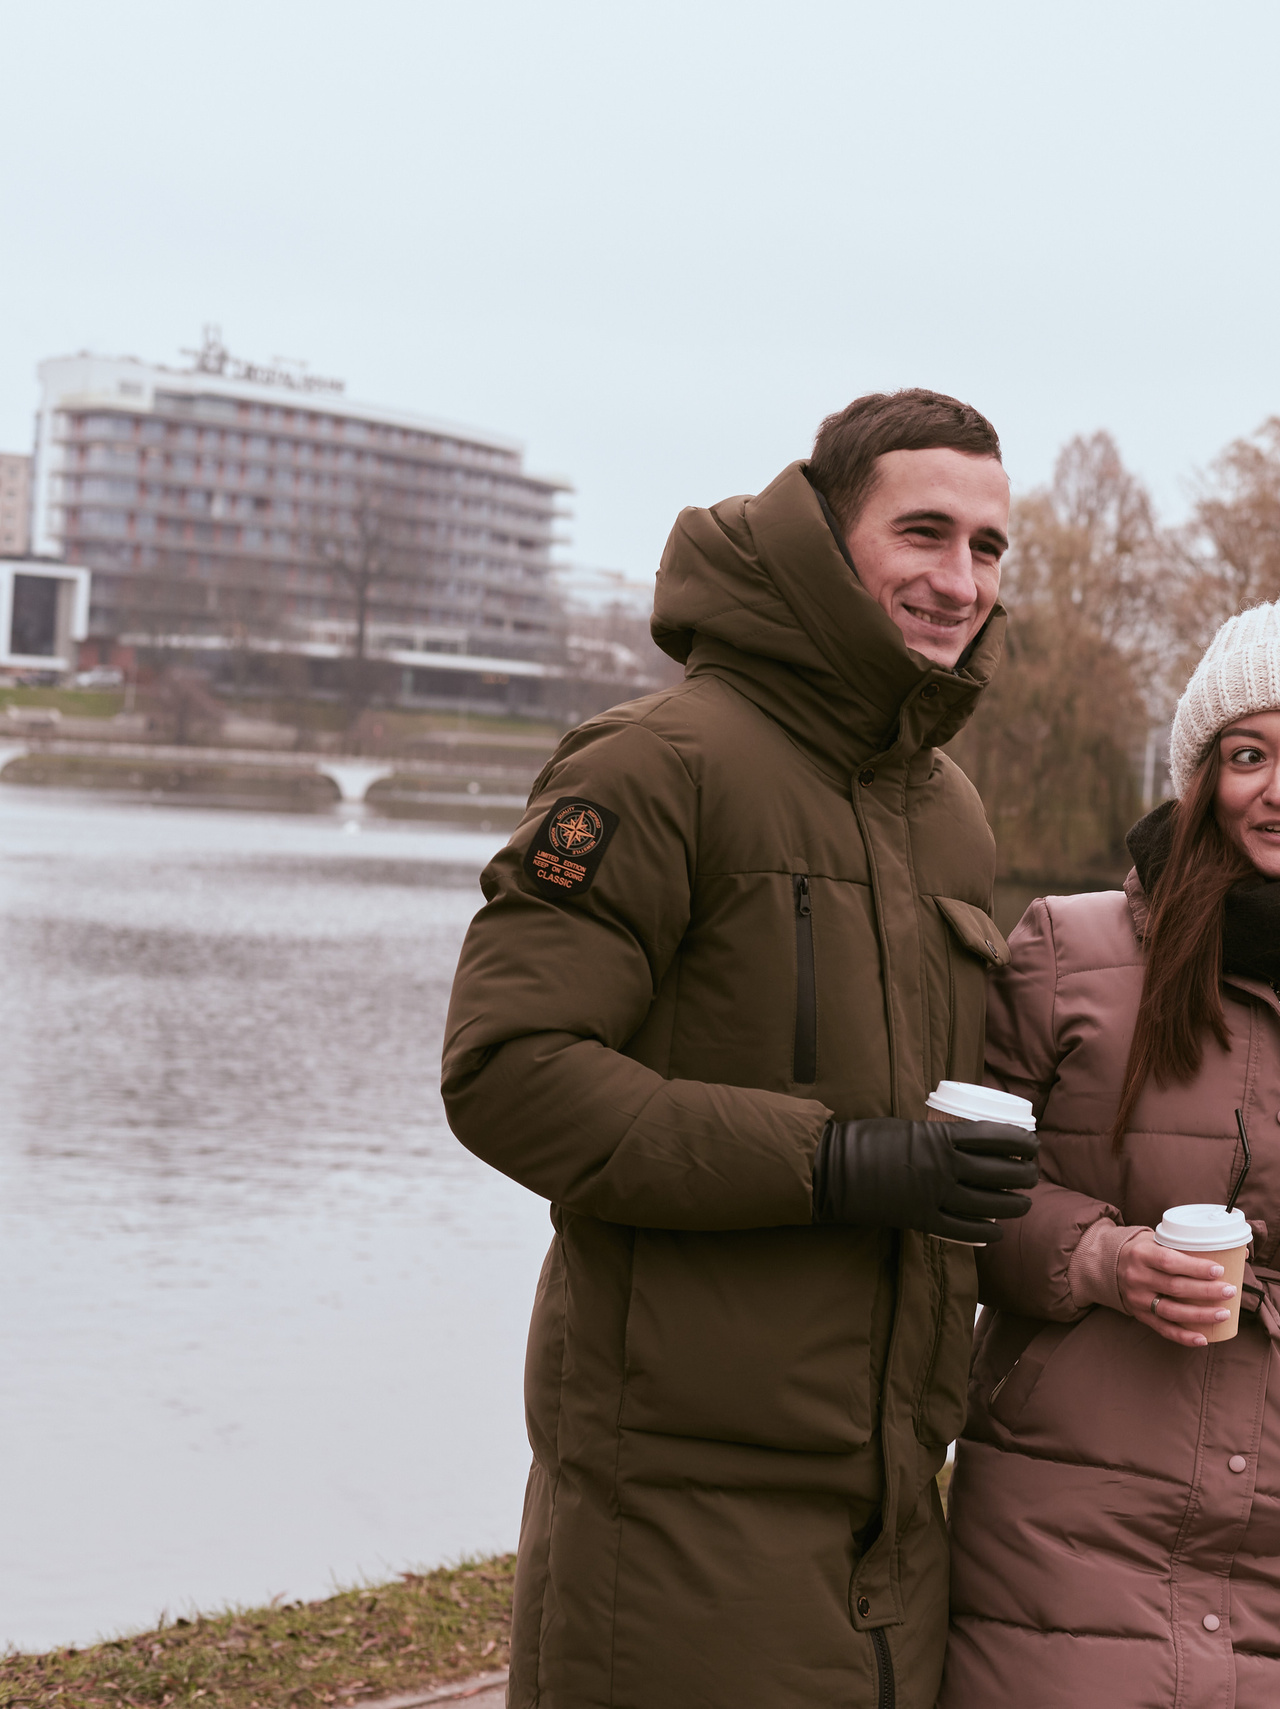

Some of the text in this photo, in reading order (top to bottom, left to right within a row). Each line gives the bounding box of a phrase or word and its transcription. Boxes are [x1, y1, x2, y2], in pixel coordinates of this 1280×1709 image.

[557, 806, 575, 819] QUALITY
[533, 859, 584, 882] KEEP ON GOING
[537, 850, 587, 873] LIMITED EDITION
[537, 869, 573, 889] CLASSIC
